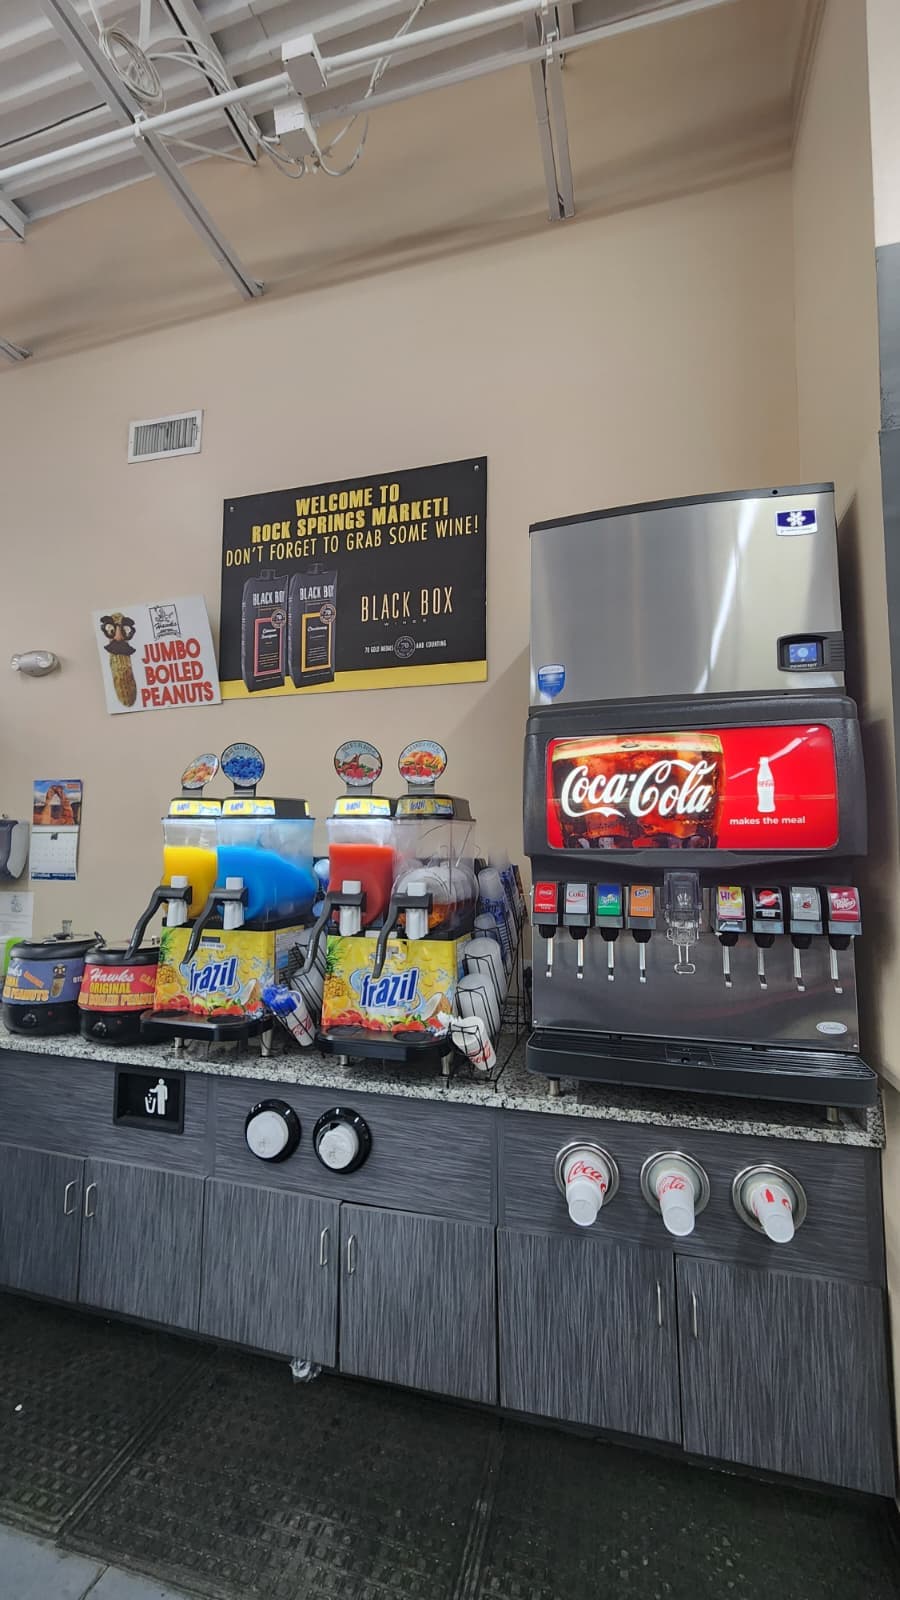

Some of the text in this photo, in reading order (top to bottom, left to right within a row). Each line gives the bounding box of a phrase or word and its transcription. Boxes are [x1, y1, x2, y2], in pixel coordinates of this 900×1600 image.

[295, 483, 400, 517] WELCOME TO
[252, 497, 449, 544] ROCK SPRINGS MARKET!
[226, 515, 479, 567] DON'T FORGET TO GRAB SOME WINE!
[253, 592, 273, 606] BLACK
[300, 586, 321, 601] BLACK
[361, 586, 453, 622] BLACK BOX
[142, 638, 201, 665] JUMBO
[416, 639, 447, 649] AND COUNTING
[145, 660, 204, 686] BOILED
[141, 681, 214, 708] PEANUTS
[561, 760, 717, 818] Coca-Cola
[729, 815, 806, 825] makes the meal
[89, 982, 132, 994] ORIGINAL
[189, 957, 238, 995] frazil
[361, 967, 419, 1008] frazil
